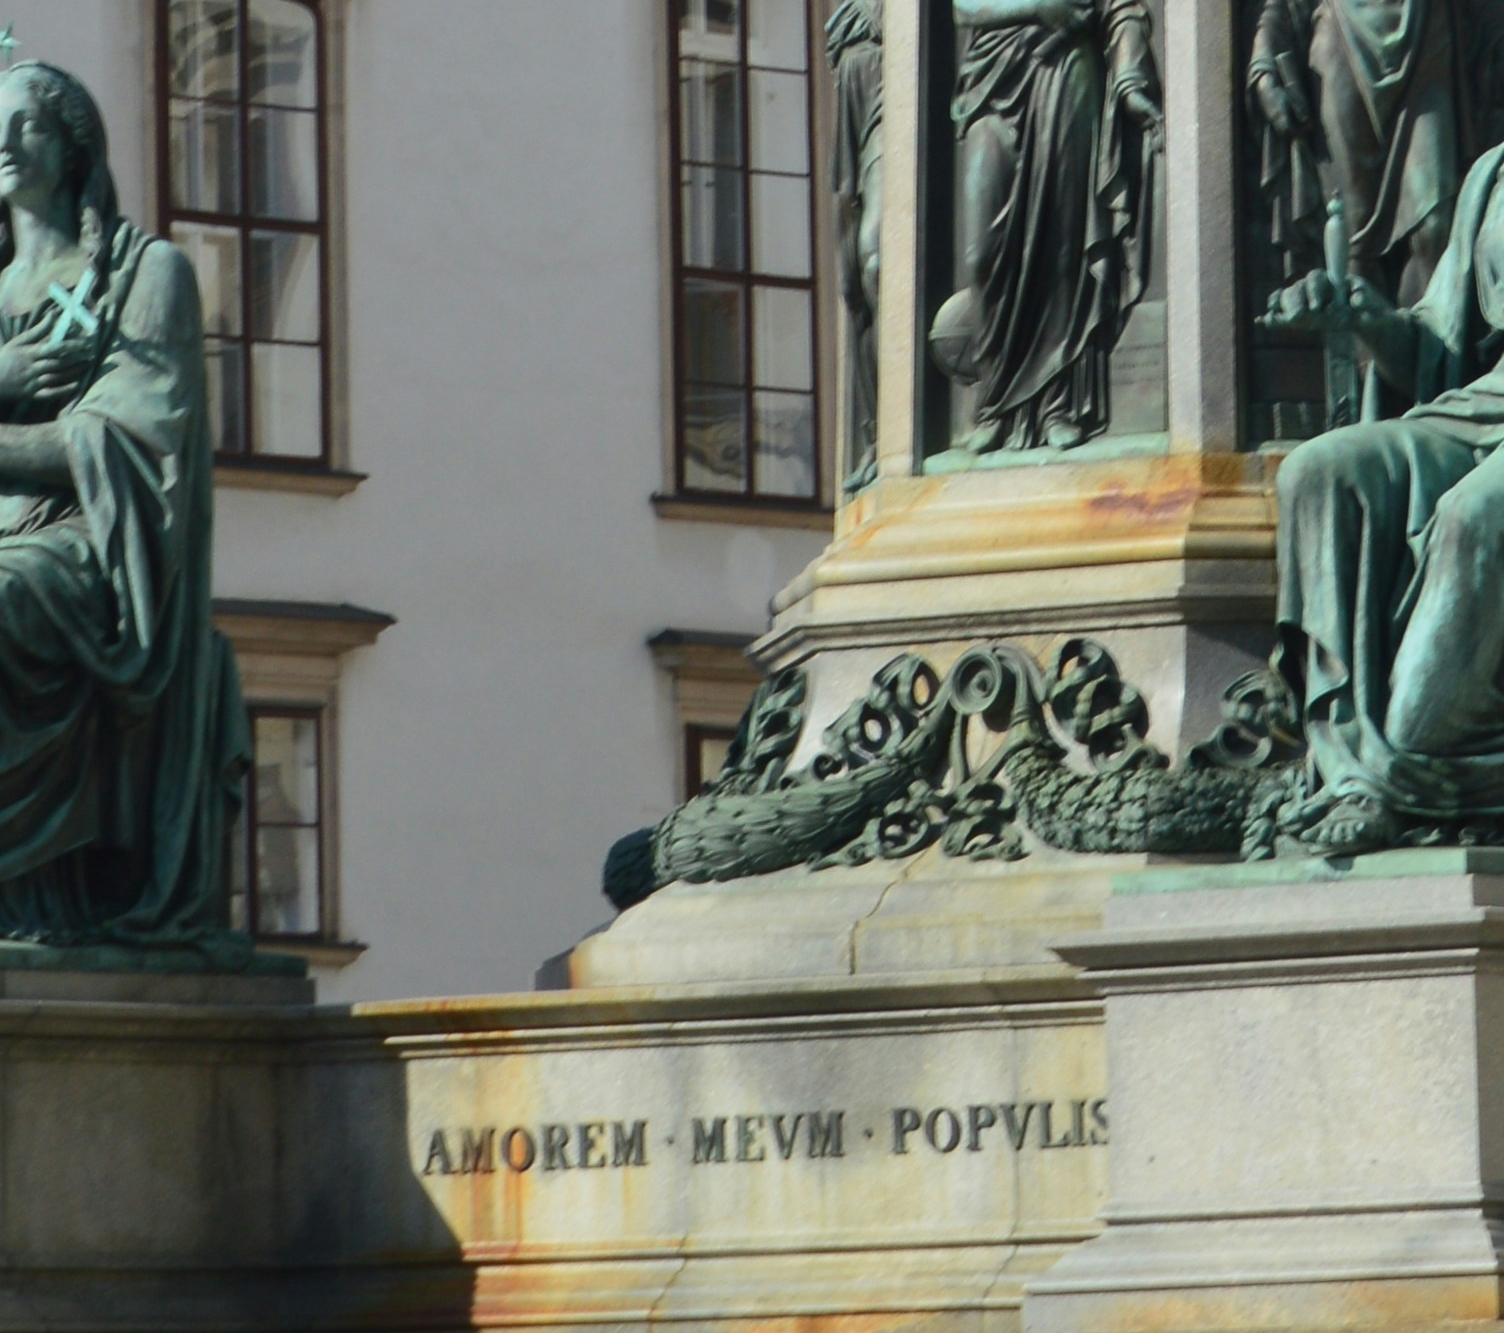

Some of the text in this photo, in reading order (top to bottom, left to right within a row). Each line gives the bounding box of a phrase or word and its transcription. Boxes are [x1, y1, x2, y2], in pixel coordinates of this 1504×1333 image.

[423, 1098, 1109, 1176] AMOREM MEVM POPVLIS
